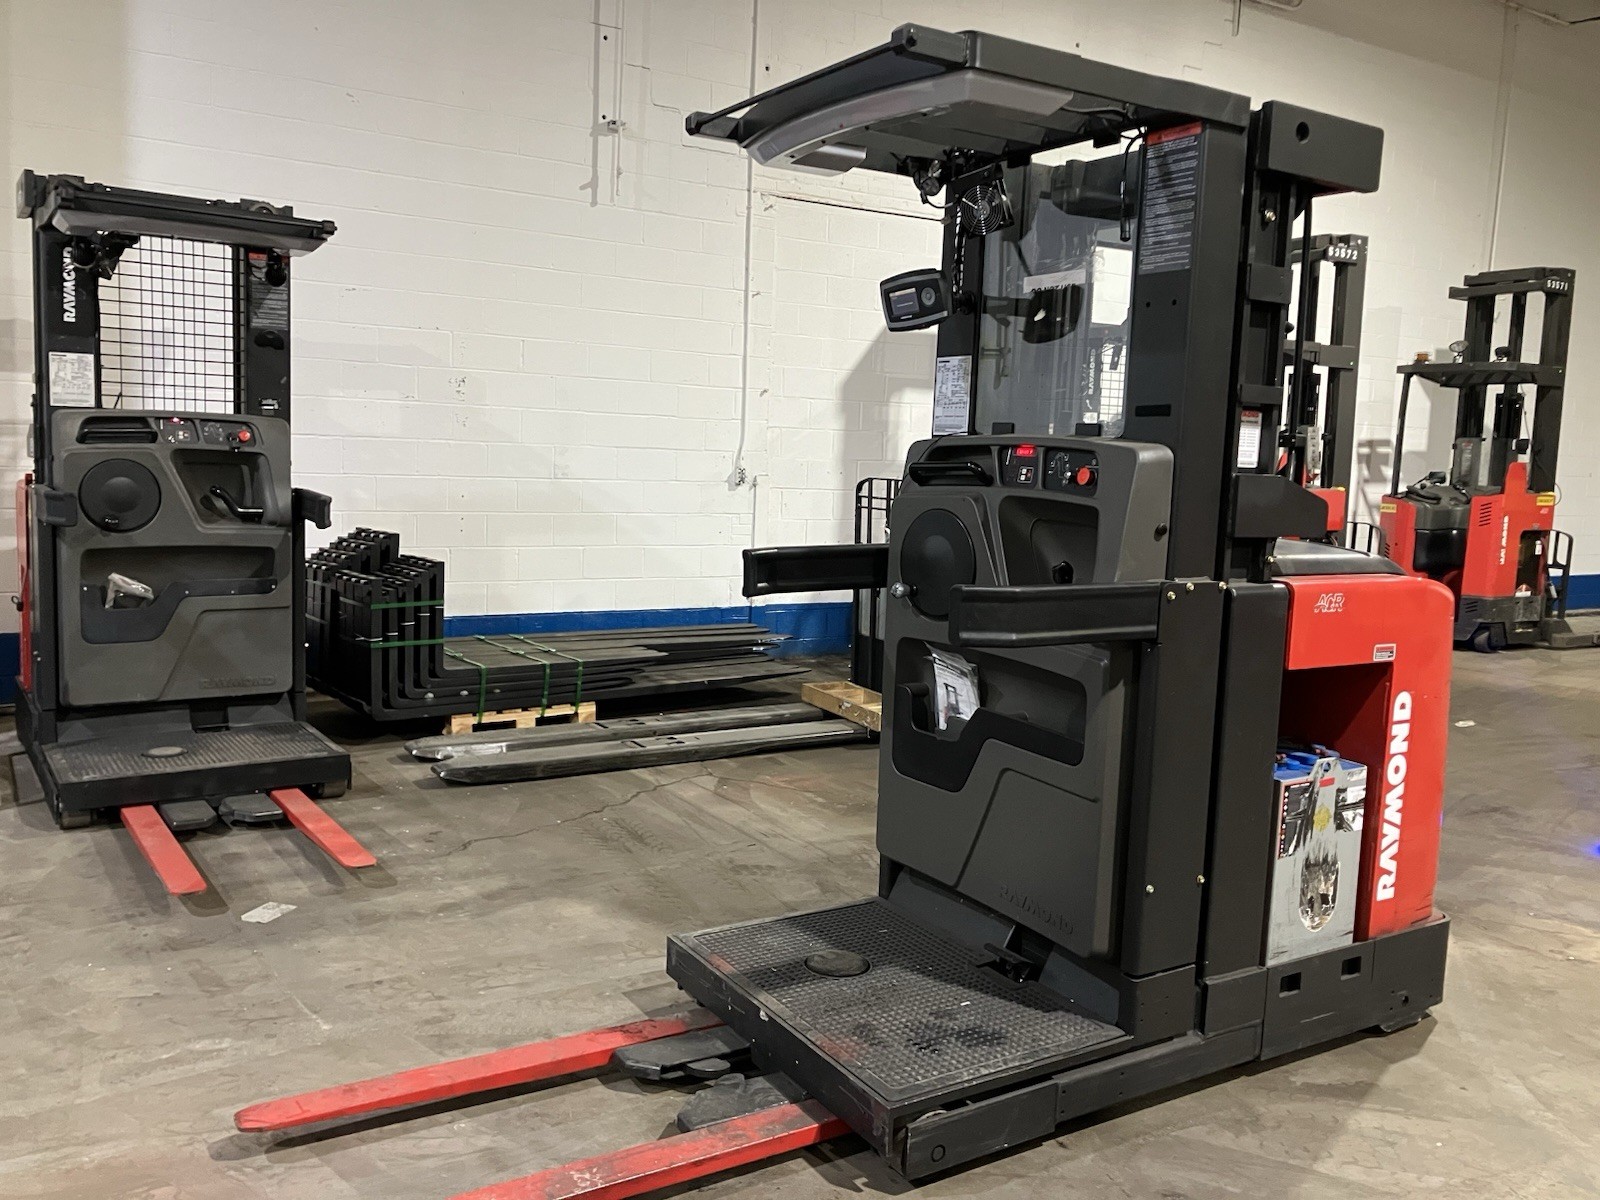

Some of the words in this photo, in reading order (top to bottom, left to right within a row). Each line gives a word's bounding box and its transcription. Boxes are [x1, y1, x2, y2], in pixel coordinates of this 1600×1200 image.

[1328, 246, 1358, 260] 53572
[1547, 279, 1568, 291] 53571
[1376, 690, 1413, 901] RAYMOND
